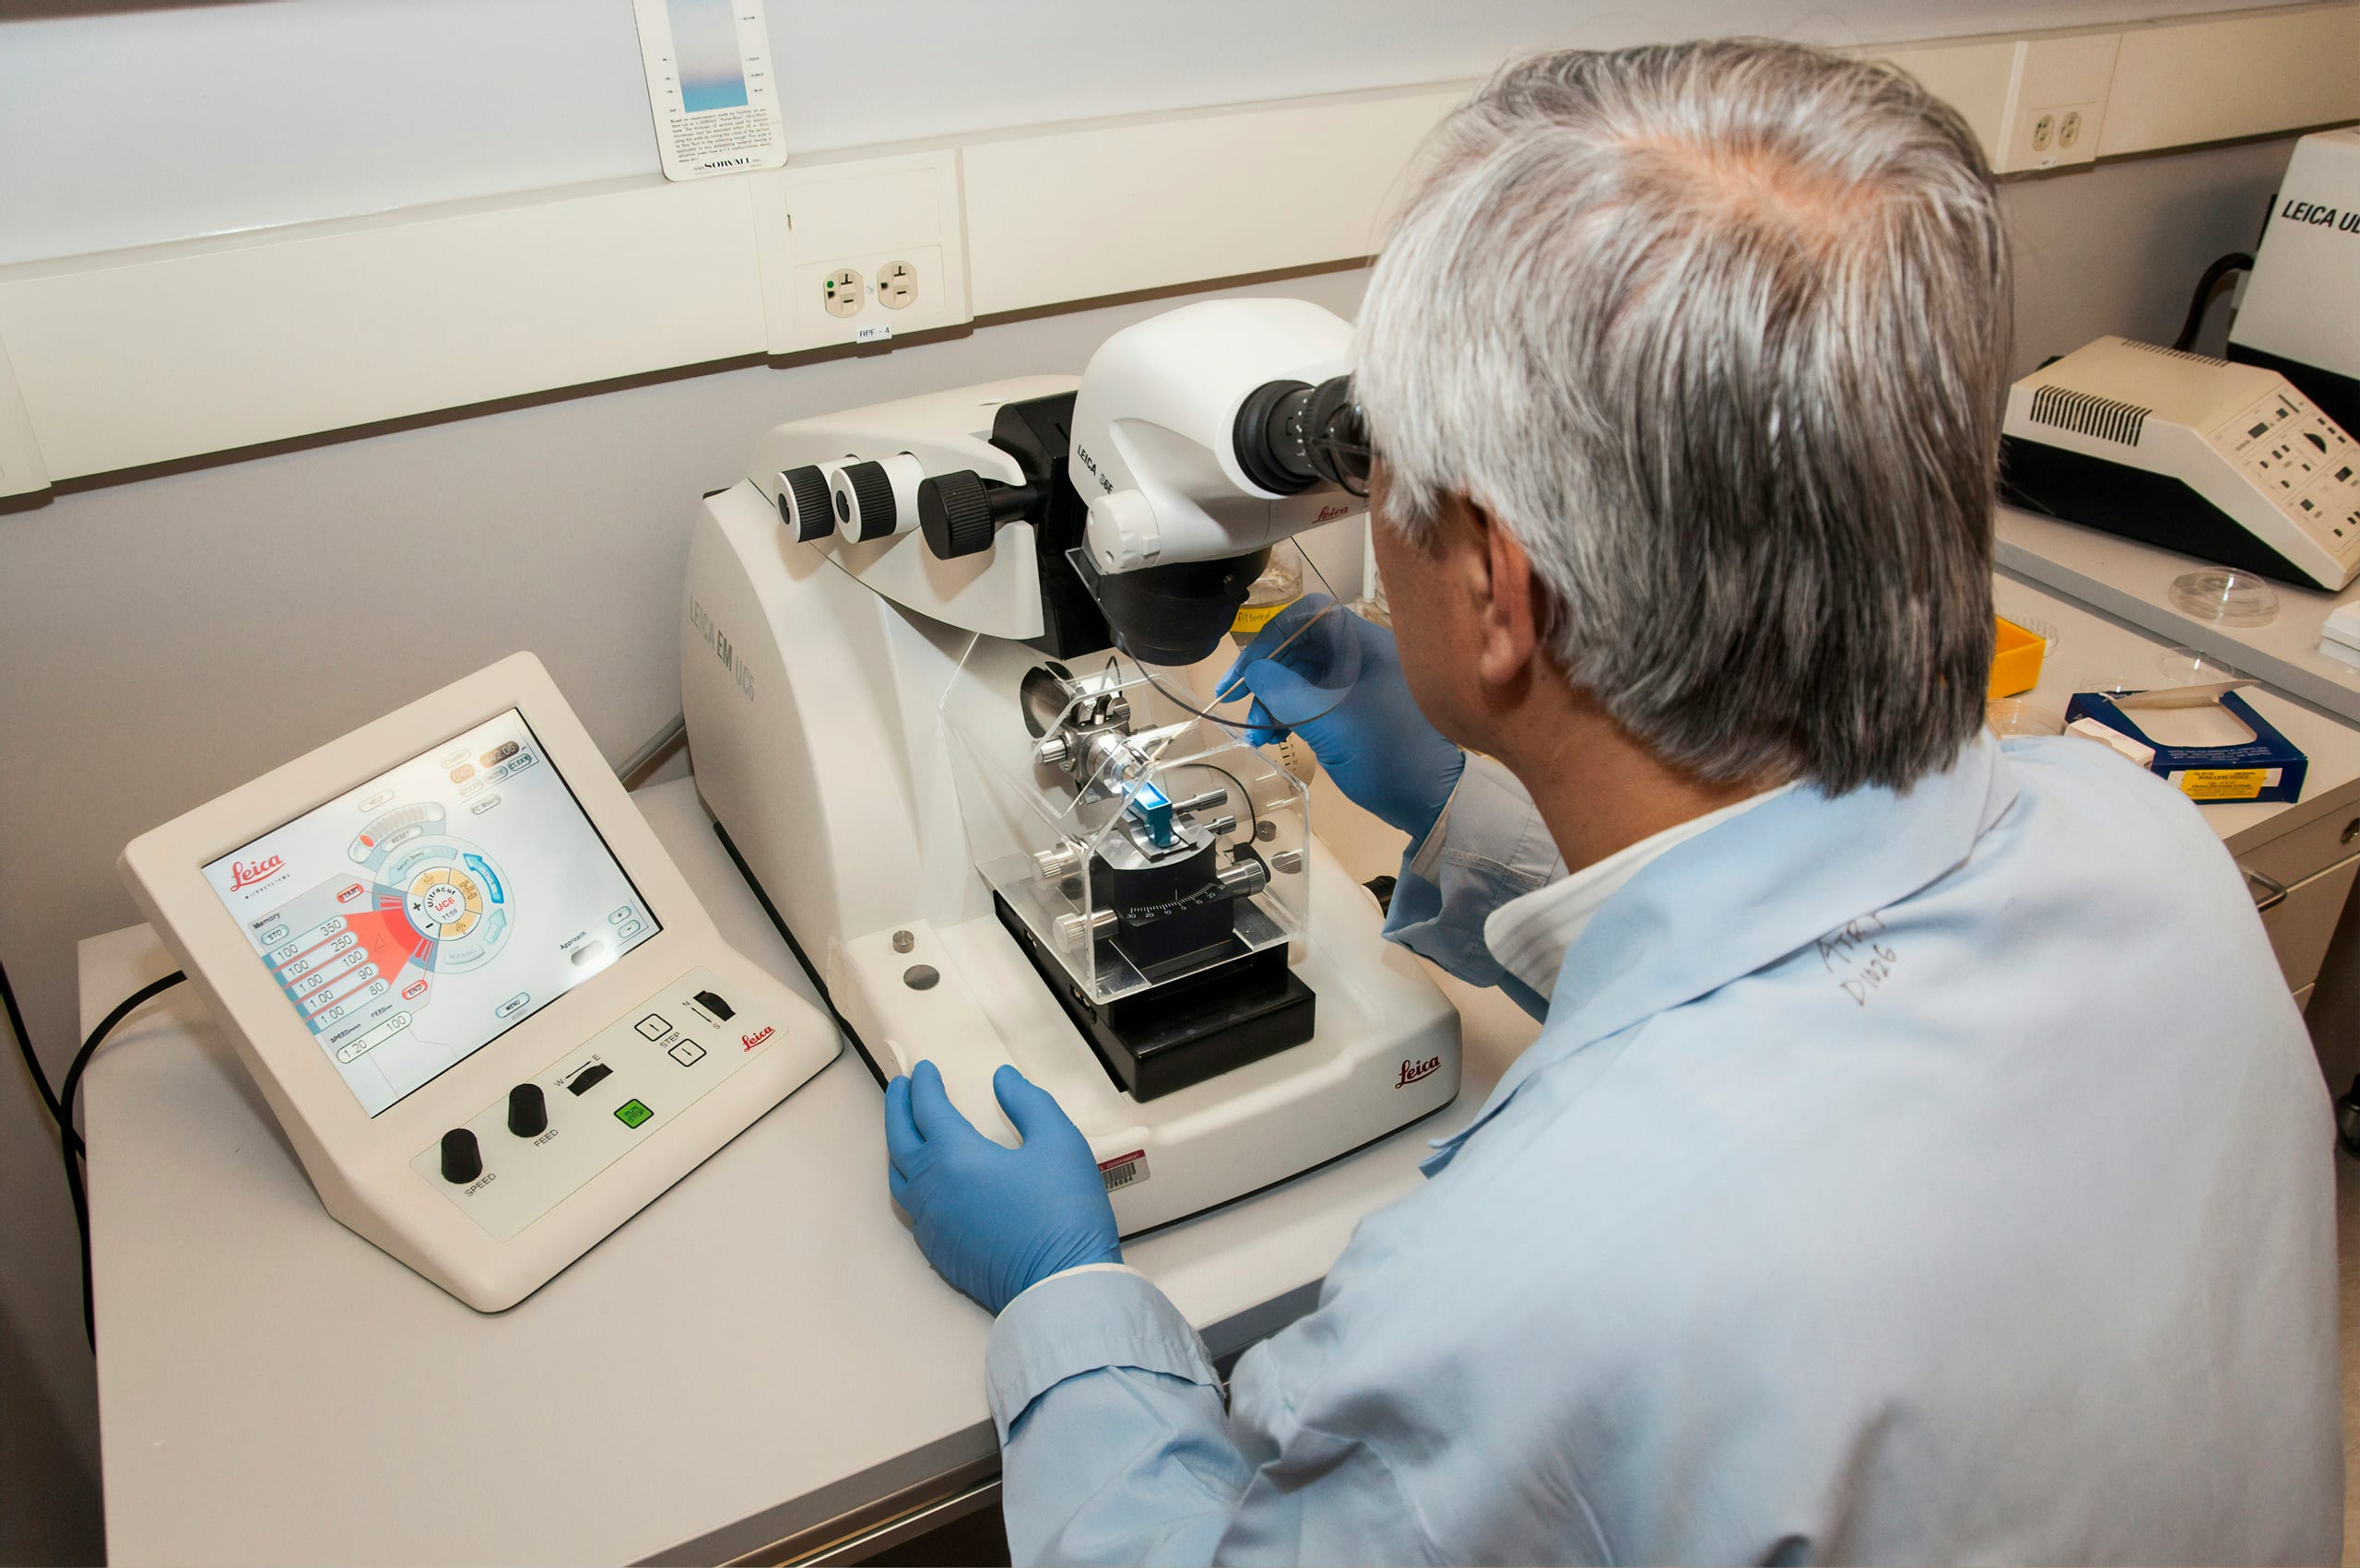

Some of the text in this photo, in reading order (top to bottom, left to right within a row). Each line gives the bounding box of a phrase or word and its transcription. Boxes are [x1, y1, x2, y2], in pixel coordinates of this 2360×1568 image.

[2282, 200, 2337, 229] LEICA
[1077, 443, 1096, 477] LEICA
[1311, 506, 1349, 525] Leica
[690, 595, 715, 650] LEICA
[717, 630, 733, 672] EM
[230, 855, 286, 892] Leica
[339, 884, 361, 902] START
[427, 887, 456, 908] Ultracut
[434, 896, 455, 912] UC6
[253, 913, 281, 930] Memory
[320, 919, 342, 937] 350
[331, 934, 353, 952] 250
[560, 931, 586, 950] Approach
[343, 950, 363, 967] 100
[358, 966, 373, 980] 90
[369, 982, 384, 996] 80
[407, 984, 423, 996] END
[505, 999, 521, 1012] MENU
[386, 1015, 407, 1032] 100
[659, 1032, 680, 1048] STEP
[741, 1026, 775, 1053] Leica
[1394, 1055, 1442, 1090] Leica
[553, 1079, 564, 1087] W
[533, 1128, 559, 1149] FEED
[464, 1173, 496, 1197] SPEED
